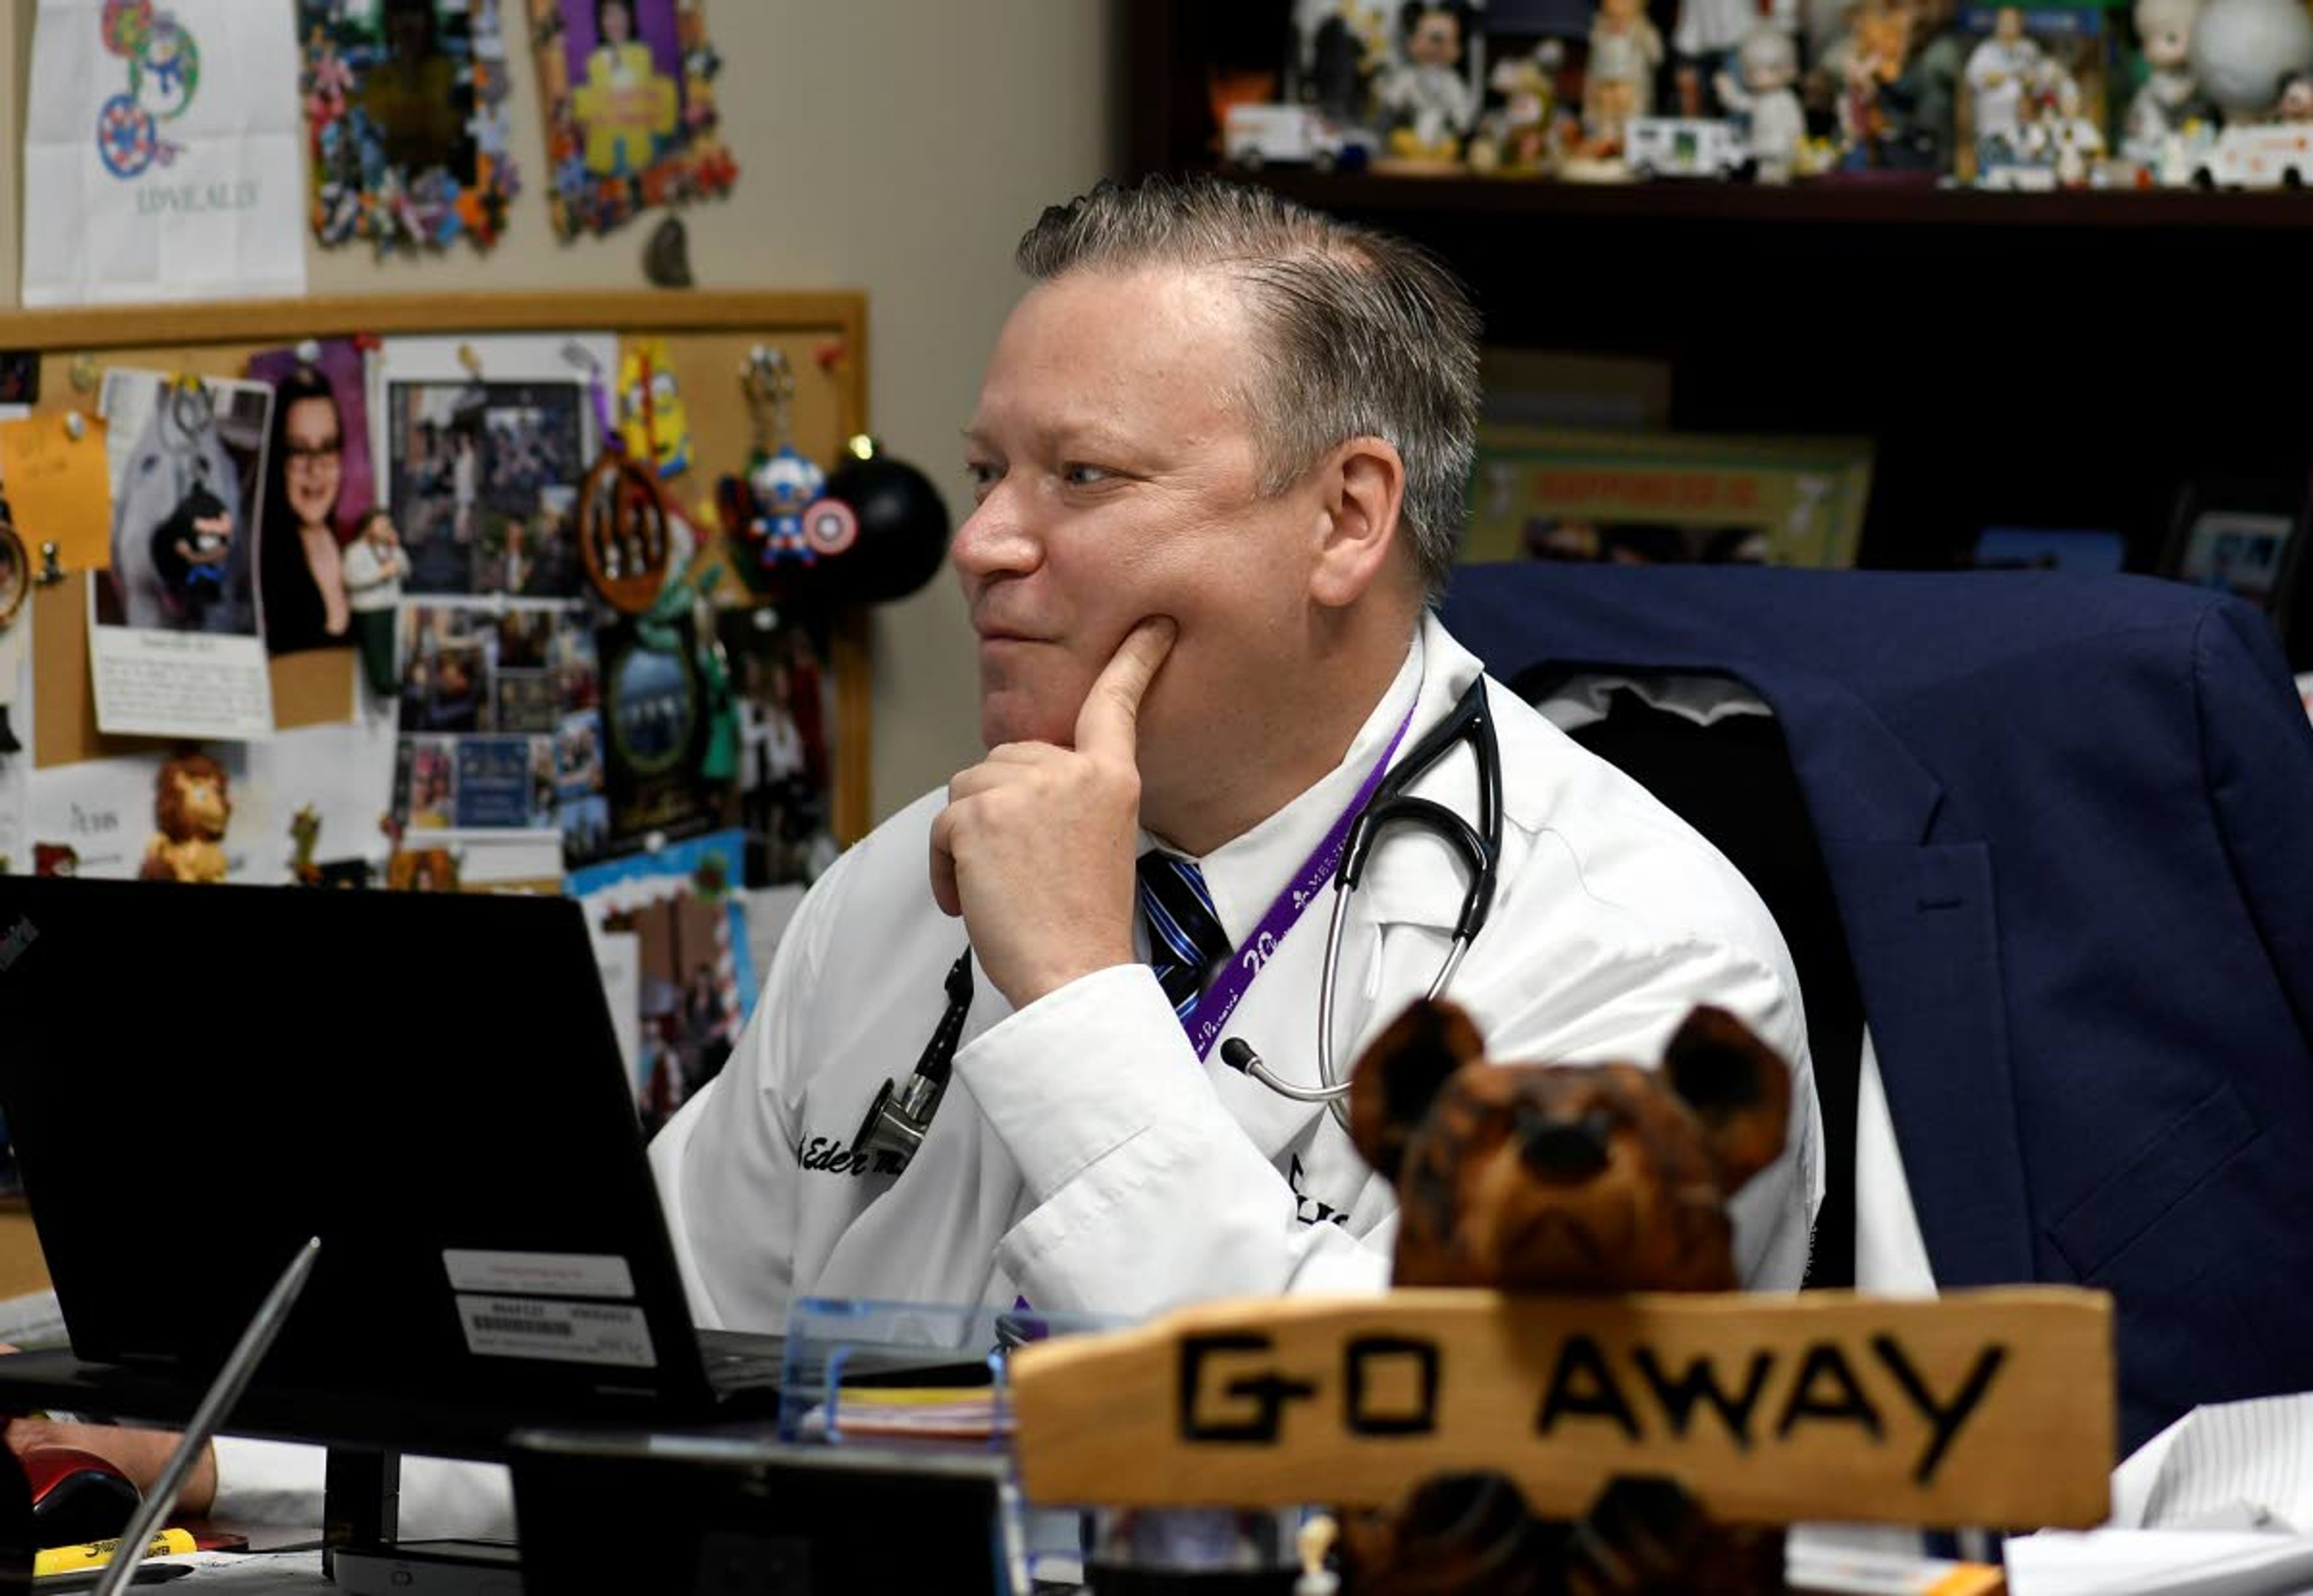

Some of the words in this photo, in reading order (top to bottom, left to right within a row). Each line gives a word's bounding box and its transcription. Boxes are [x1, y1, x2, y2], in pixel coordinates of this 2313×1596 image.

[803, 1136, 869, 1176] Eder
[1177, 1335, 1440, 1443] GO
[1534, 1331, 2011, 1485] AWAY
